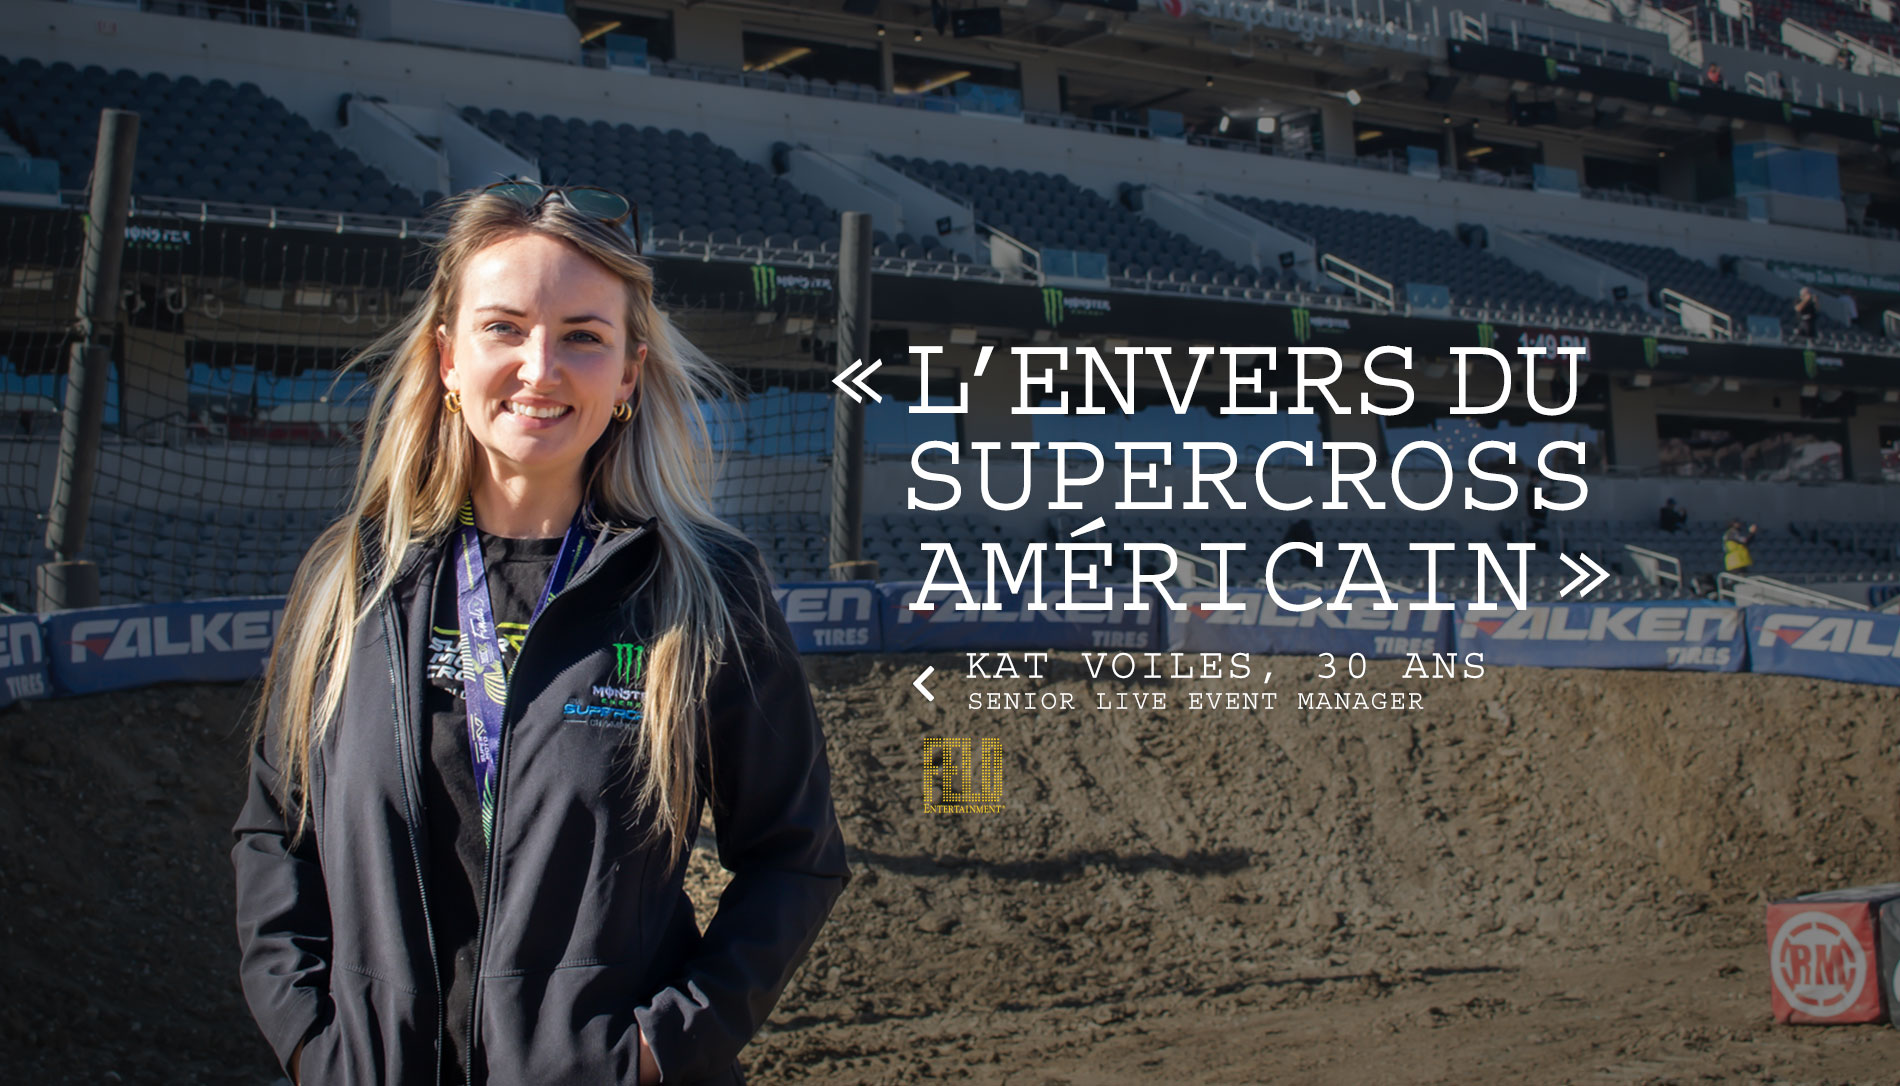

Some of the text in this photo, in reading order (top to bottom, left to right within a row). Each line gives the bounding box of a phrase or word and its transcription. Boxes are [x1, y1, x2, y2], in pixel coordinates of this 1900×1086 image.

[896, 588, 1155, 625] FALKEN
[1174, 590, 1446, 633] FALKEN
[813, 628, 869, 647] TIRES
[1091, 629, 1148, 649] TIRES
[1460, 604, 1742, 643] FALKEN
[1759, 613, 1900, 659] FAL
[1374, 636, 1436, 655] TIRES
[1666, 646, 1731, 667] TIRES
[7, 673, 45, 699] TIRES
[1789, 943, 1847, 986] RM
